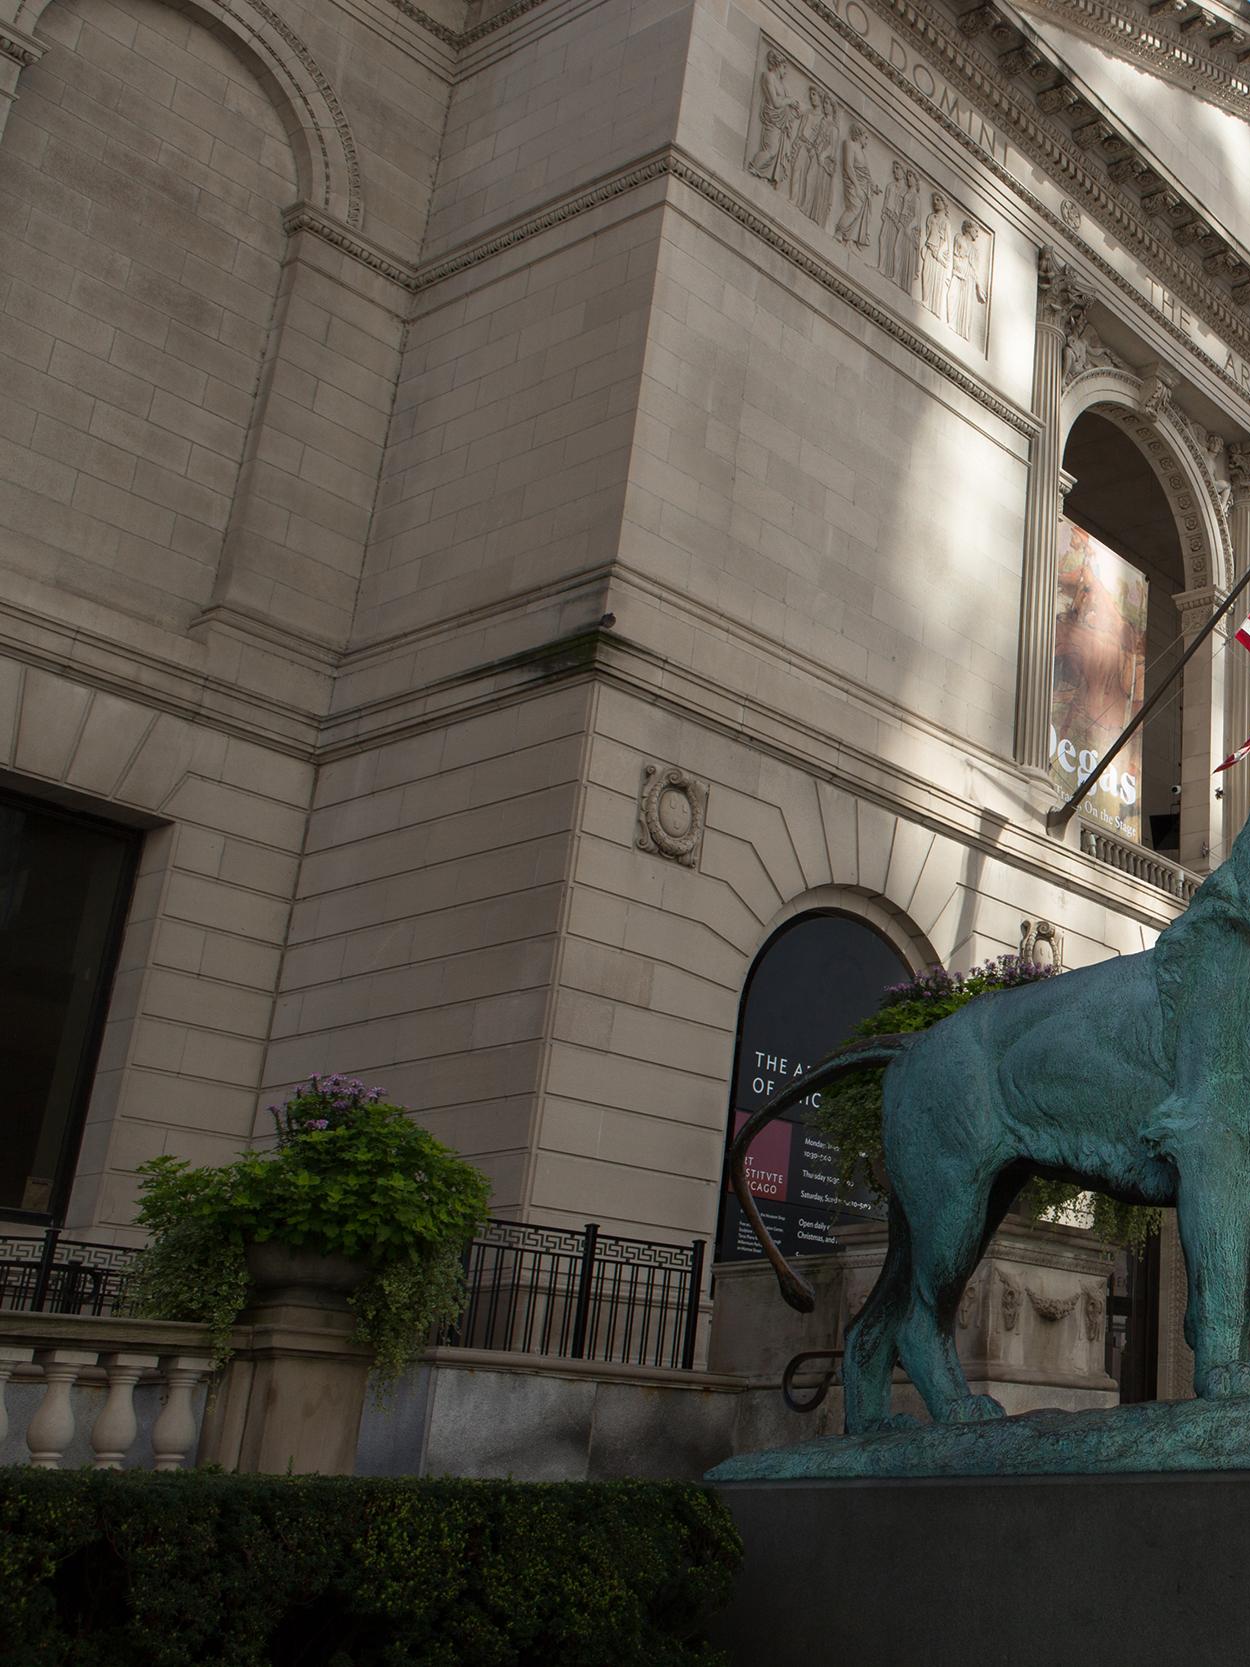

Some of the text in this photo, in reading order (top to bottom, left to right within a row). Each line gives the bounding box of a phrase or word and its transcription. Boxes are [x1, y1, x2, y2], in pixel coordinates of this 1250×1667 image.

[888, 36, 1009, 167] DOMINI
[1145, 276, 1192, 338] THE
[1084, 800, 1098, 818] On
[1100, 808, 1113, 825] the
[1114, 815, 1136, 838] Stage
[755, 1051, 788, 1075] THE
[752, 1077, 775, 1096] OF
[745, 1168, 784, 1184] STITVTE
[798, 1218, 813, 1229] Open
[814, 1220, 827, 1232] daily
[825, 1236, 835, 1244] and
